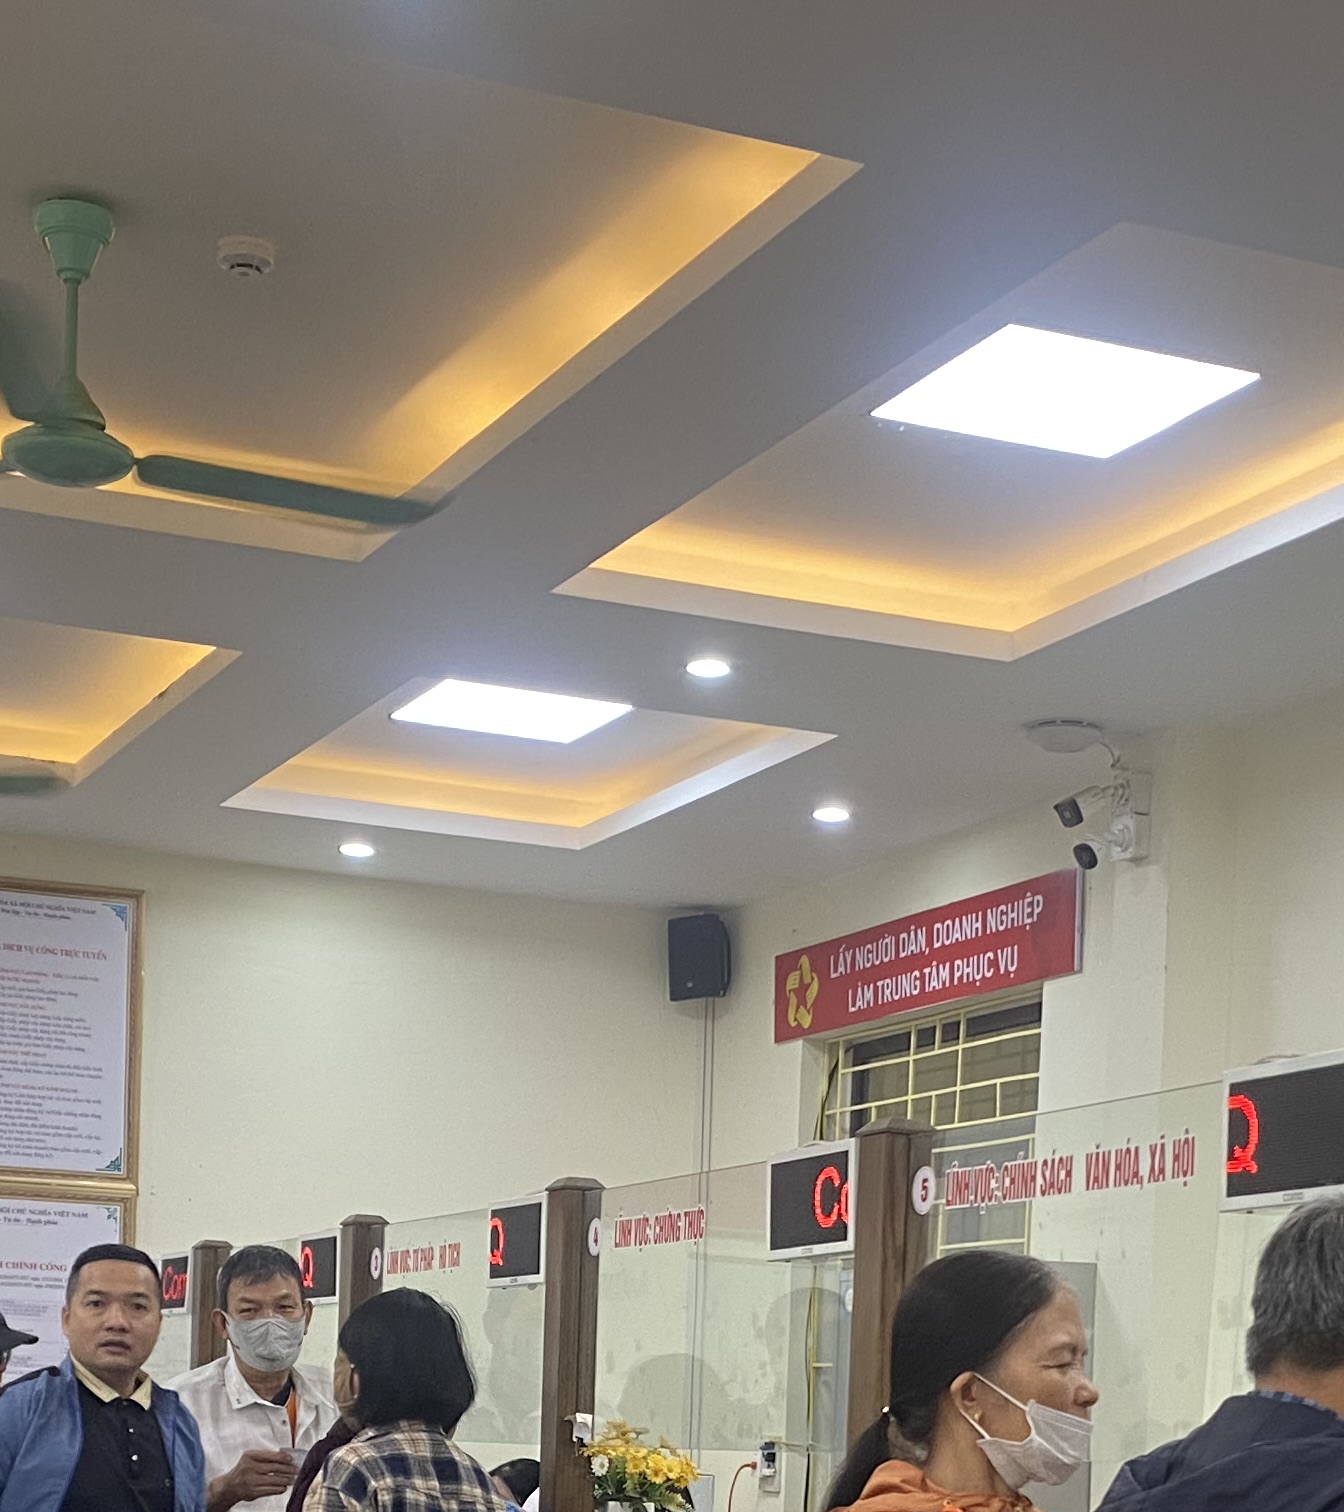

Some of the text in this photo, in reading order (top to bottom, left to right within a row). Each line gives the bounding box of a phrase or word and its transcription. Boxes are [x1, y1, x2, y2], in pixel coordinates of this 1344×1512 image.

[830, 892, 1044, 978] LẤY NGƯỜI DÂN, DOANH NGHIỆP
[848, 945, 1019, 1012] LÀM TRUNG TÂM PHỤC VỤ
[1001, 1151, 1037, 1202] CHÍNH
[1040, 1150, 1074, 1197] SÁCH
[1085, 1143, 1109, 1191] VĂN
[1114, 1137, 1144, 1190] HÓA,
[1148, 1133, 1167, 1184] XÃ
[1172, 1128, 1196, 1187] HỘI
[683, 1204, 705, 1246] THỰC
